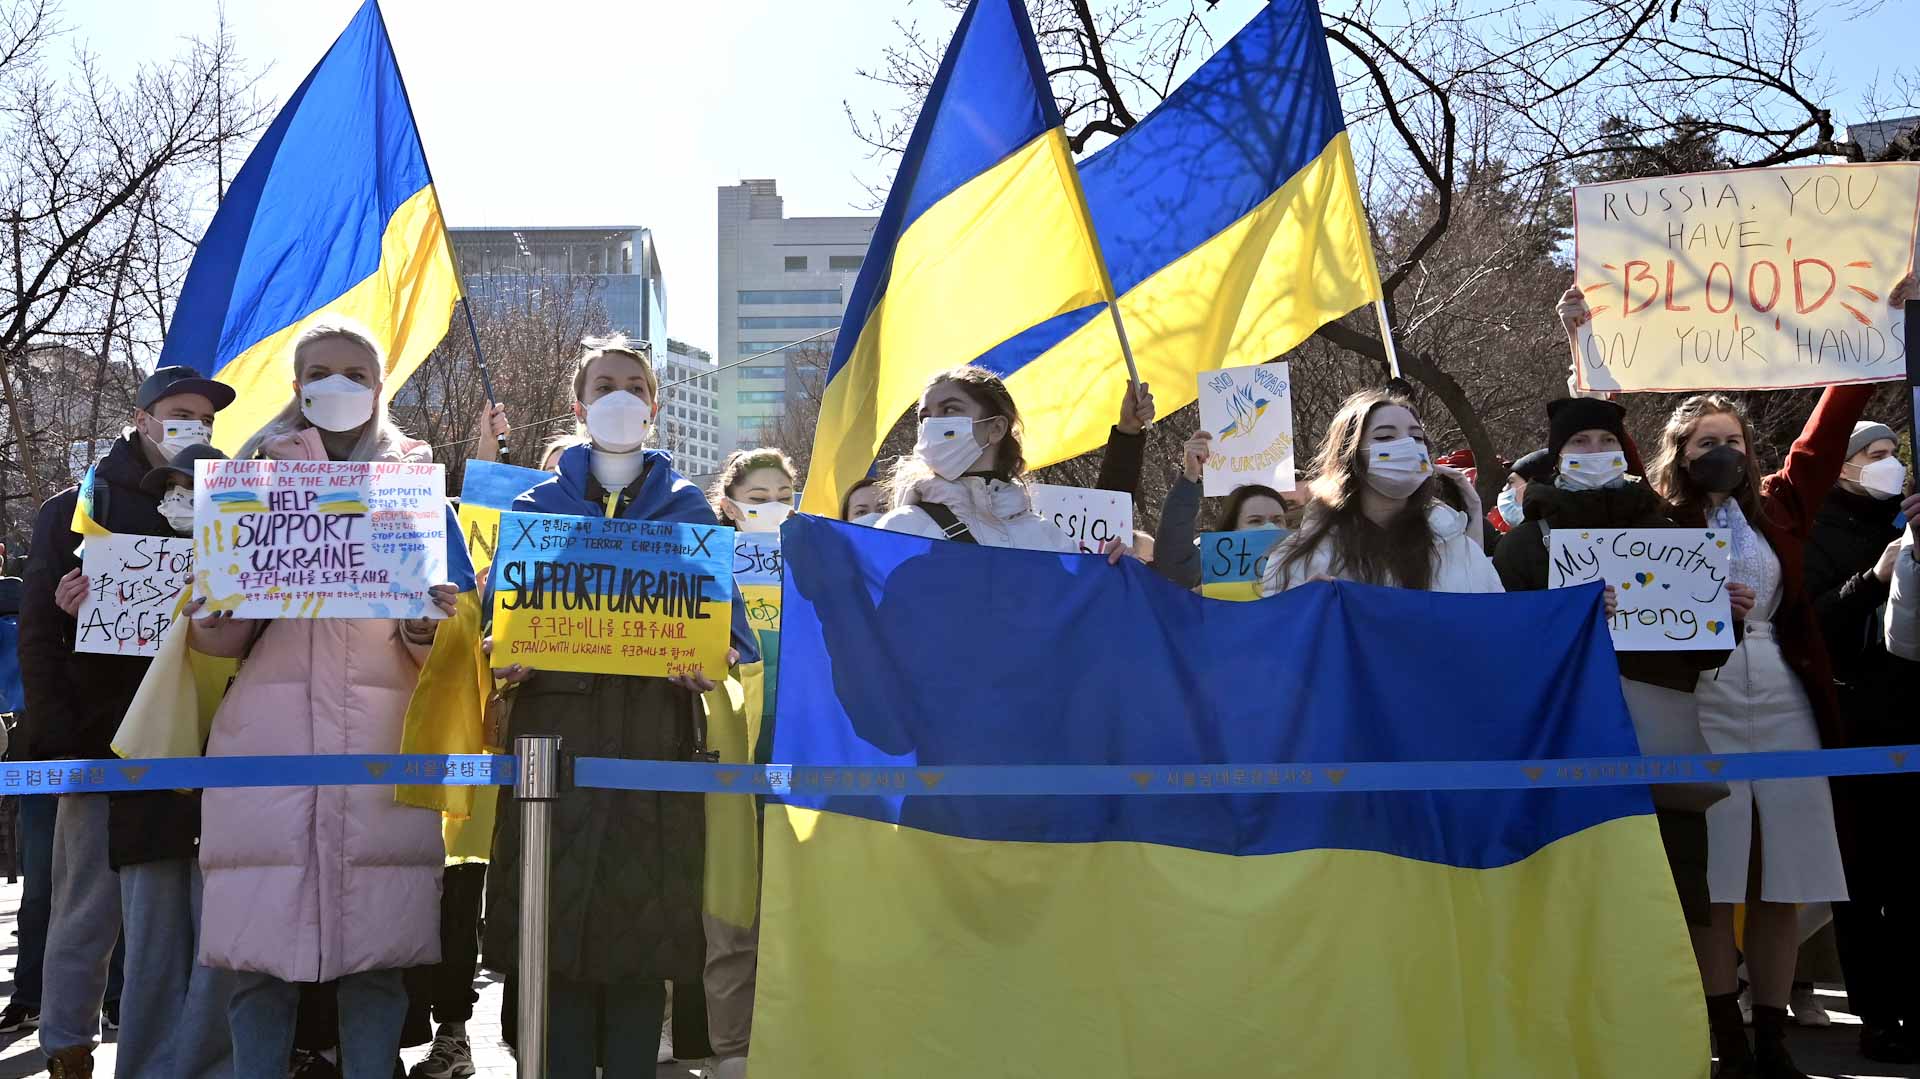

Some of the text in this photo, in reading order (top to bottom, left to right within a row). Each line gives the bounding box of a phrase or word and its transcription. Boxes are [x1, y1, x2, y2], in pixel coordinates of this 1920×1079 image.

[1780, 175, 1879, 216] YOU
[1668, 221, 1774, 250] HAVE
[1623, 258, 1836, 318] BLOOD
[1586, 321, 1905, 369] ON YOUR HANDS
[1208, 368, 1287, 397] NO WAR
[1231, 432, 1292, 472] UKRAINE
[204, 477, 236, 489] WHO
[241, 476, 272, 487] WILL
[278, 477, 296, 487] BE
[300, 477, 323, 487] THE
[207, 462, 220, 474] IF
[291, 462, 370, 474] AGGRESSION
[376, 463, 401, 474] NOT
[406, 464, 437, 475] STOP
[269, 490, 317, 512] HELP
[236, 513, 365, 550] SUPPORT
[371, 532, 393, 541] STOP
[603, 521, 637, 534] STOP
[250, 542, 365, 572] UKRAINE
[541, 535, 576, 551] STOP
[583, 537, 623, 549] TERROR
[1554, 532, 1726, 603] My Country
[528, 616, 614, 638] 우크라이나를
[511, 640, 547, 654] STAND
[549, 641, 569, 654] WITH
[572, 643, 613, 655] UKRAINE
